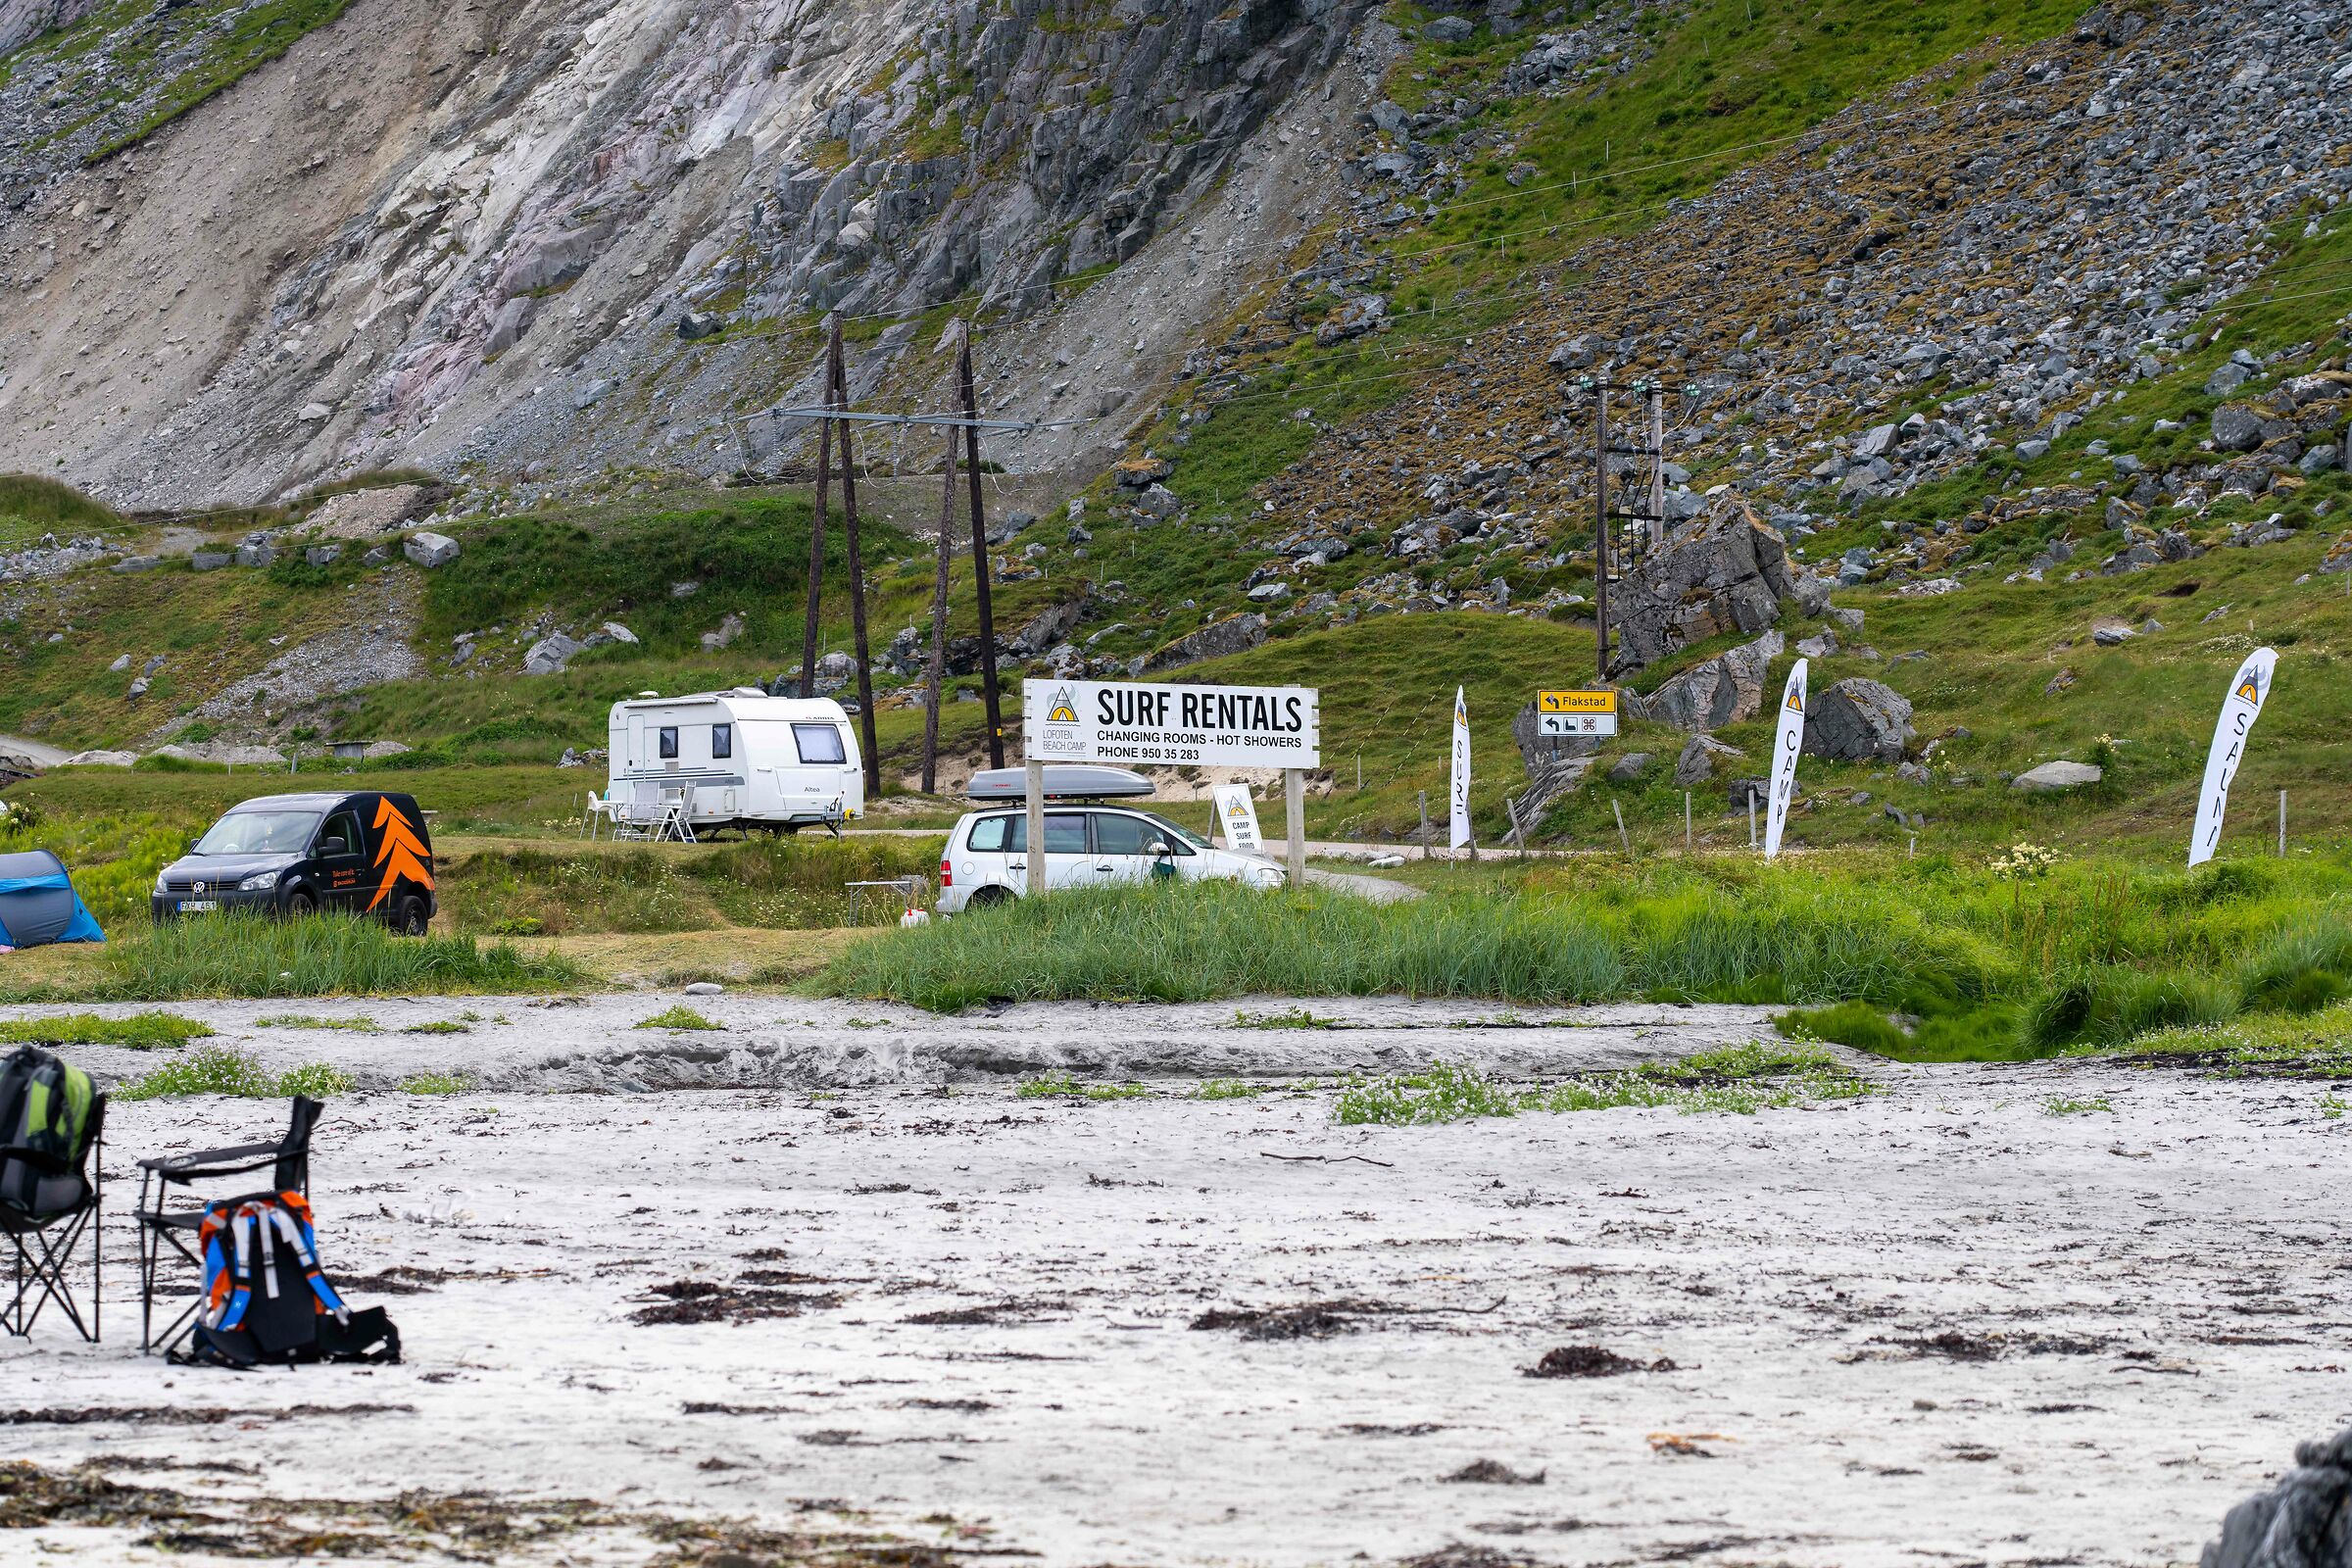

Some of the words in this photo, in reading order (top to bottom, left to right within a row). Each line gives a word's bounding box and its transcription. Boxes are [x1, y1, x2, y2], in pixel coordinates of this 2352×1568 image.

[1562, 696, 1606, 707] Flakstad
[1097, 688, 1171, 727] SURF
[1182, 692, 1302, 733] RENTALS
[1042, 729, 1073, 740] LOFOTEN
[1097, 730, 1160, 744] CHANGING
[1163, 731, 1206, 745] ROOMS
[1216, 733, 1241, 746] HOT
[1244, 735, 1302, 749] SHOWERS
[1043, 740, 1066, 751] BEACH
[1067, 741, 1087, 752] CAMP
[1097, 746, 1139, 759] PHONE
[1142, 747, 1161, 760] 950
[1163, 748, 1177, 760] 35
[1180, 748, 1200, 760] 283
[1777, 729, 1797, 825] CAMP
[1235, 831, 1251, 840] SURF
